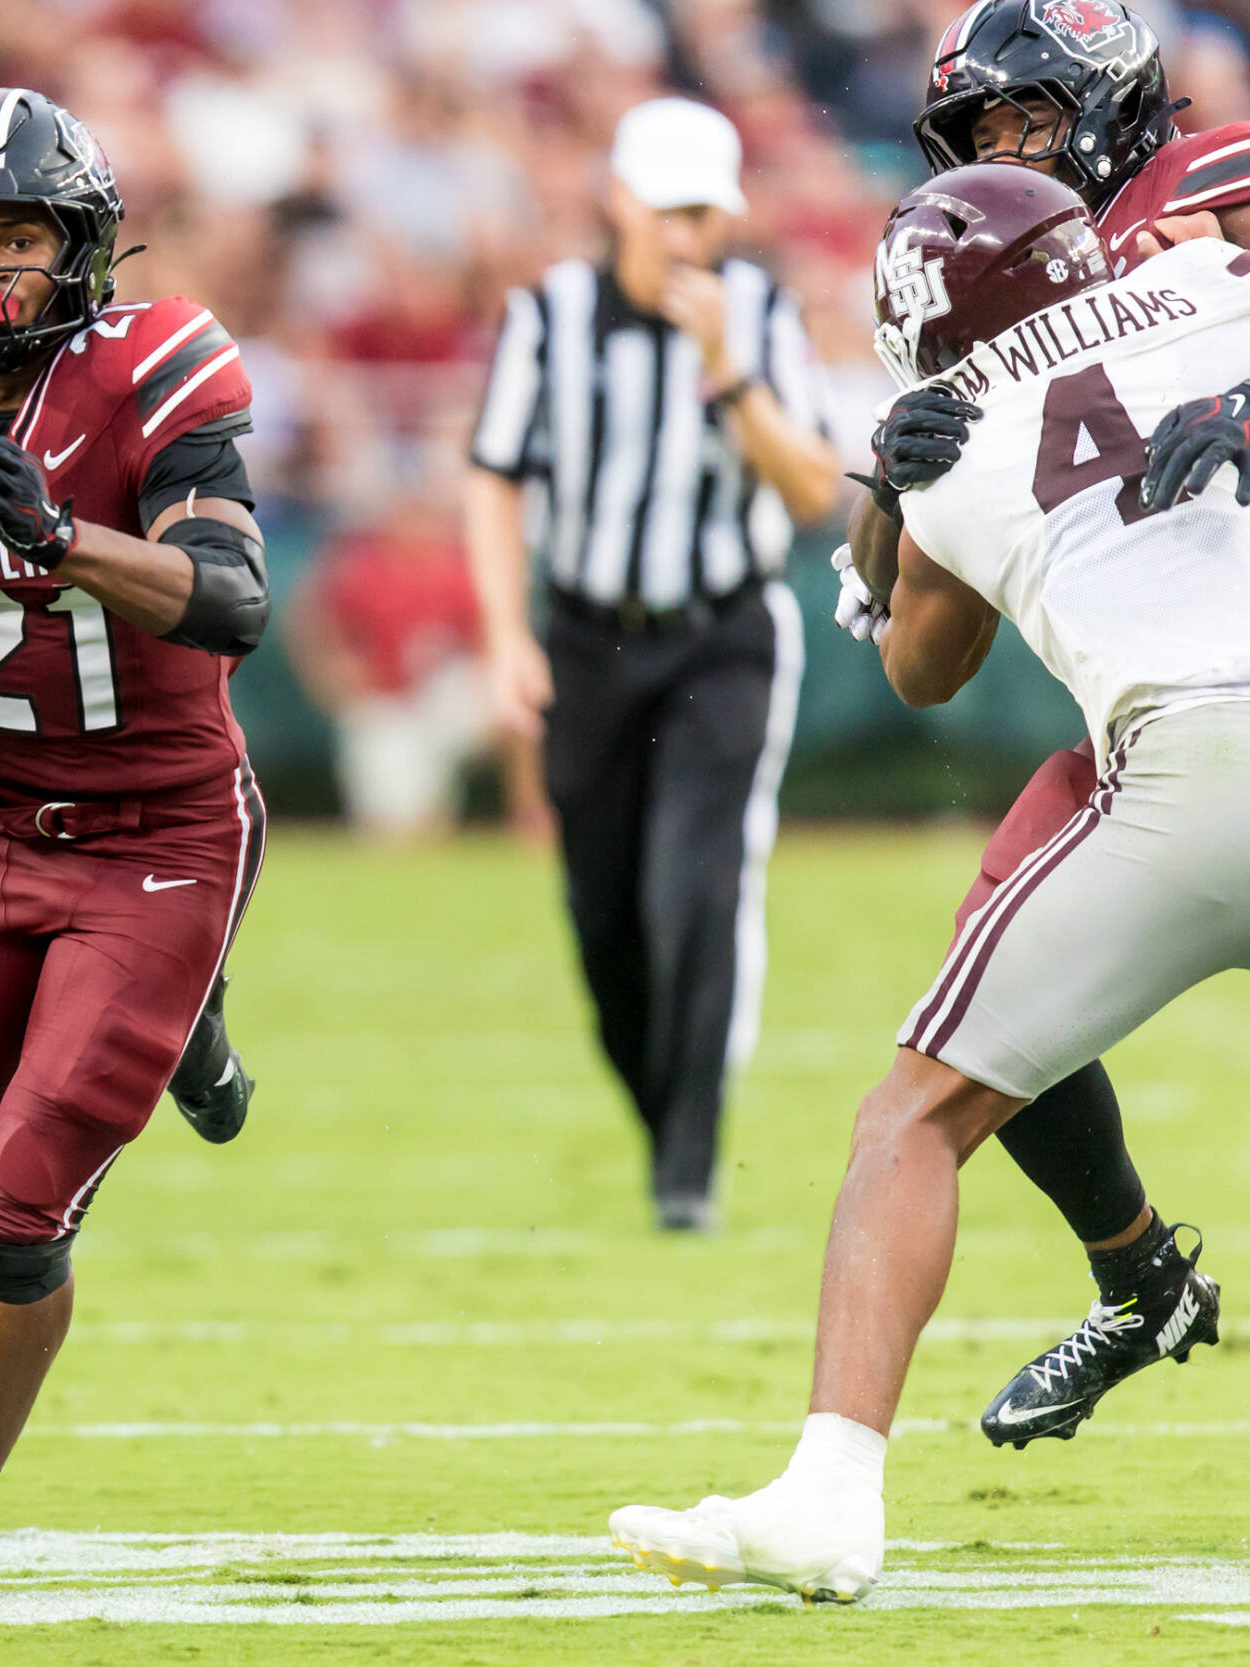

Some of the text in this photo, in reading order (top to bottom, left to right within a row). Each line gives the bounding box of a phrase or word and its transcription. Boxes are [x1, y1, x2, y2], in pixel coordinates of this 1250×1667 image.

[988, 289, 1197, 382] WILLIAMS
[1032, 362, 1194, 526] 4
[1155, 1282, 1200, 1358] NIKE
